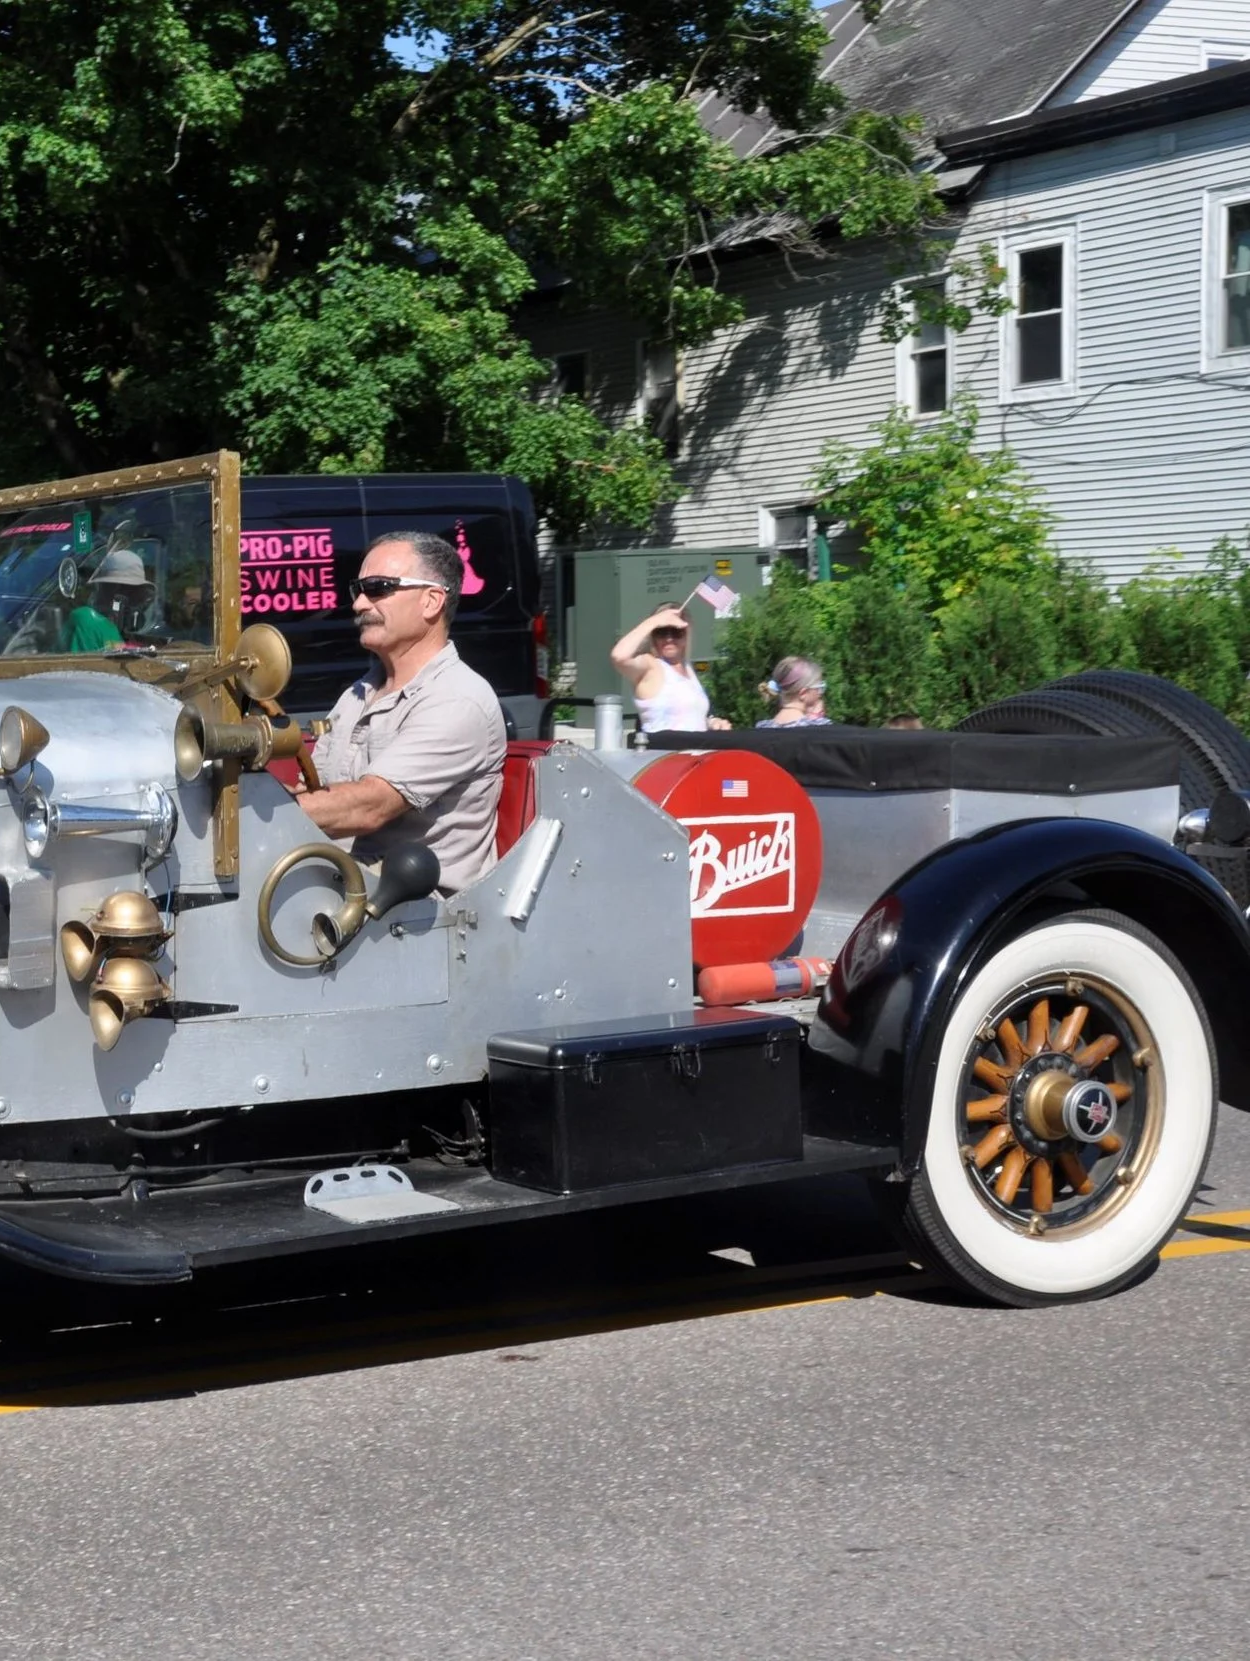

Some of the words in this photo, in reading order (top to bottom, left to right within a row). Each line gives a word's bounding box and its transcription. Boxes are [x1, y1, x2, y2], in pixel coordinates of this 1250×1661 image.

[240, 567, 334, 591] SWINE
[240, 591, 337, 613] COOLER
[689, 820, 791, 912] Buick
